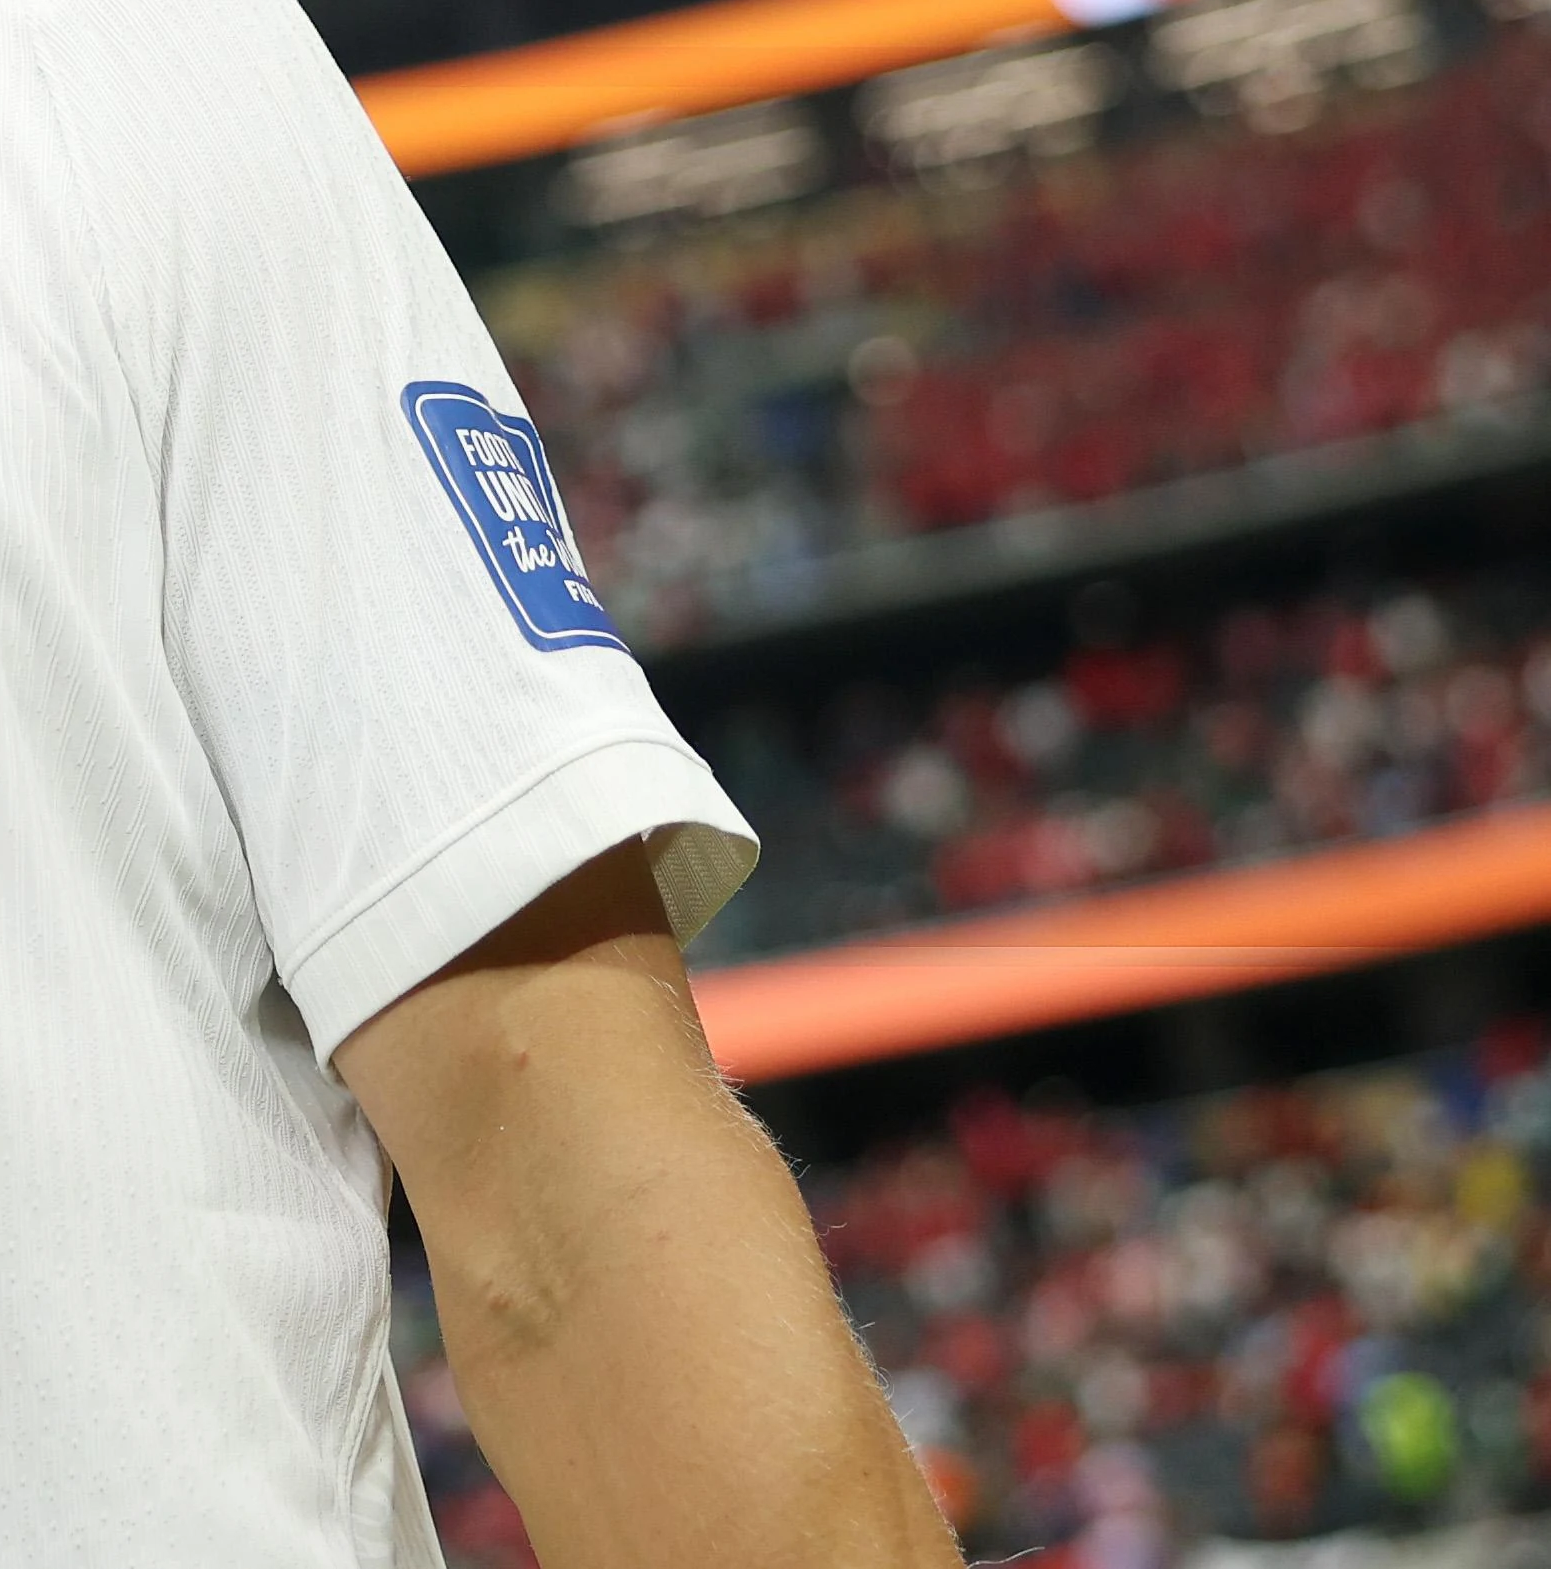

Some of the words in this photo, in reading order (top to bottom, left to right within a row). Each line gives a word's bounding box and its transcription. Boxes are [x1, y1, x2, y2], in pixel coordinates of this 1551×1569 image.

[456, 429, 526, 473] FOOT
[475, 471, 554, 528] UNI
[502, 526, 555, 572] the
